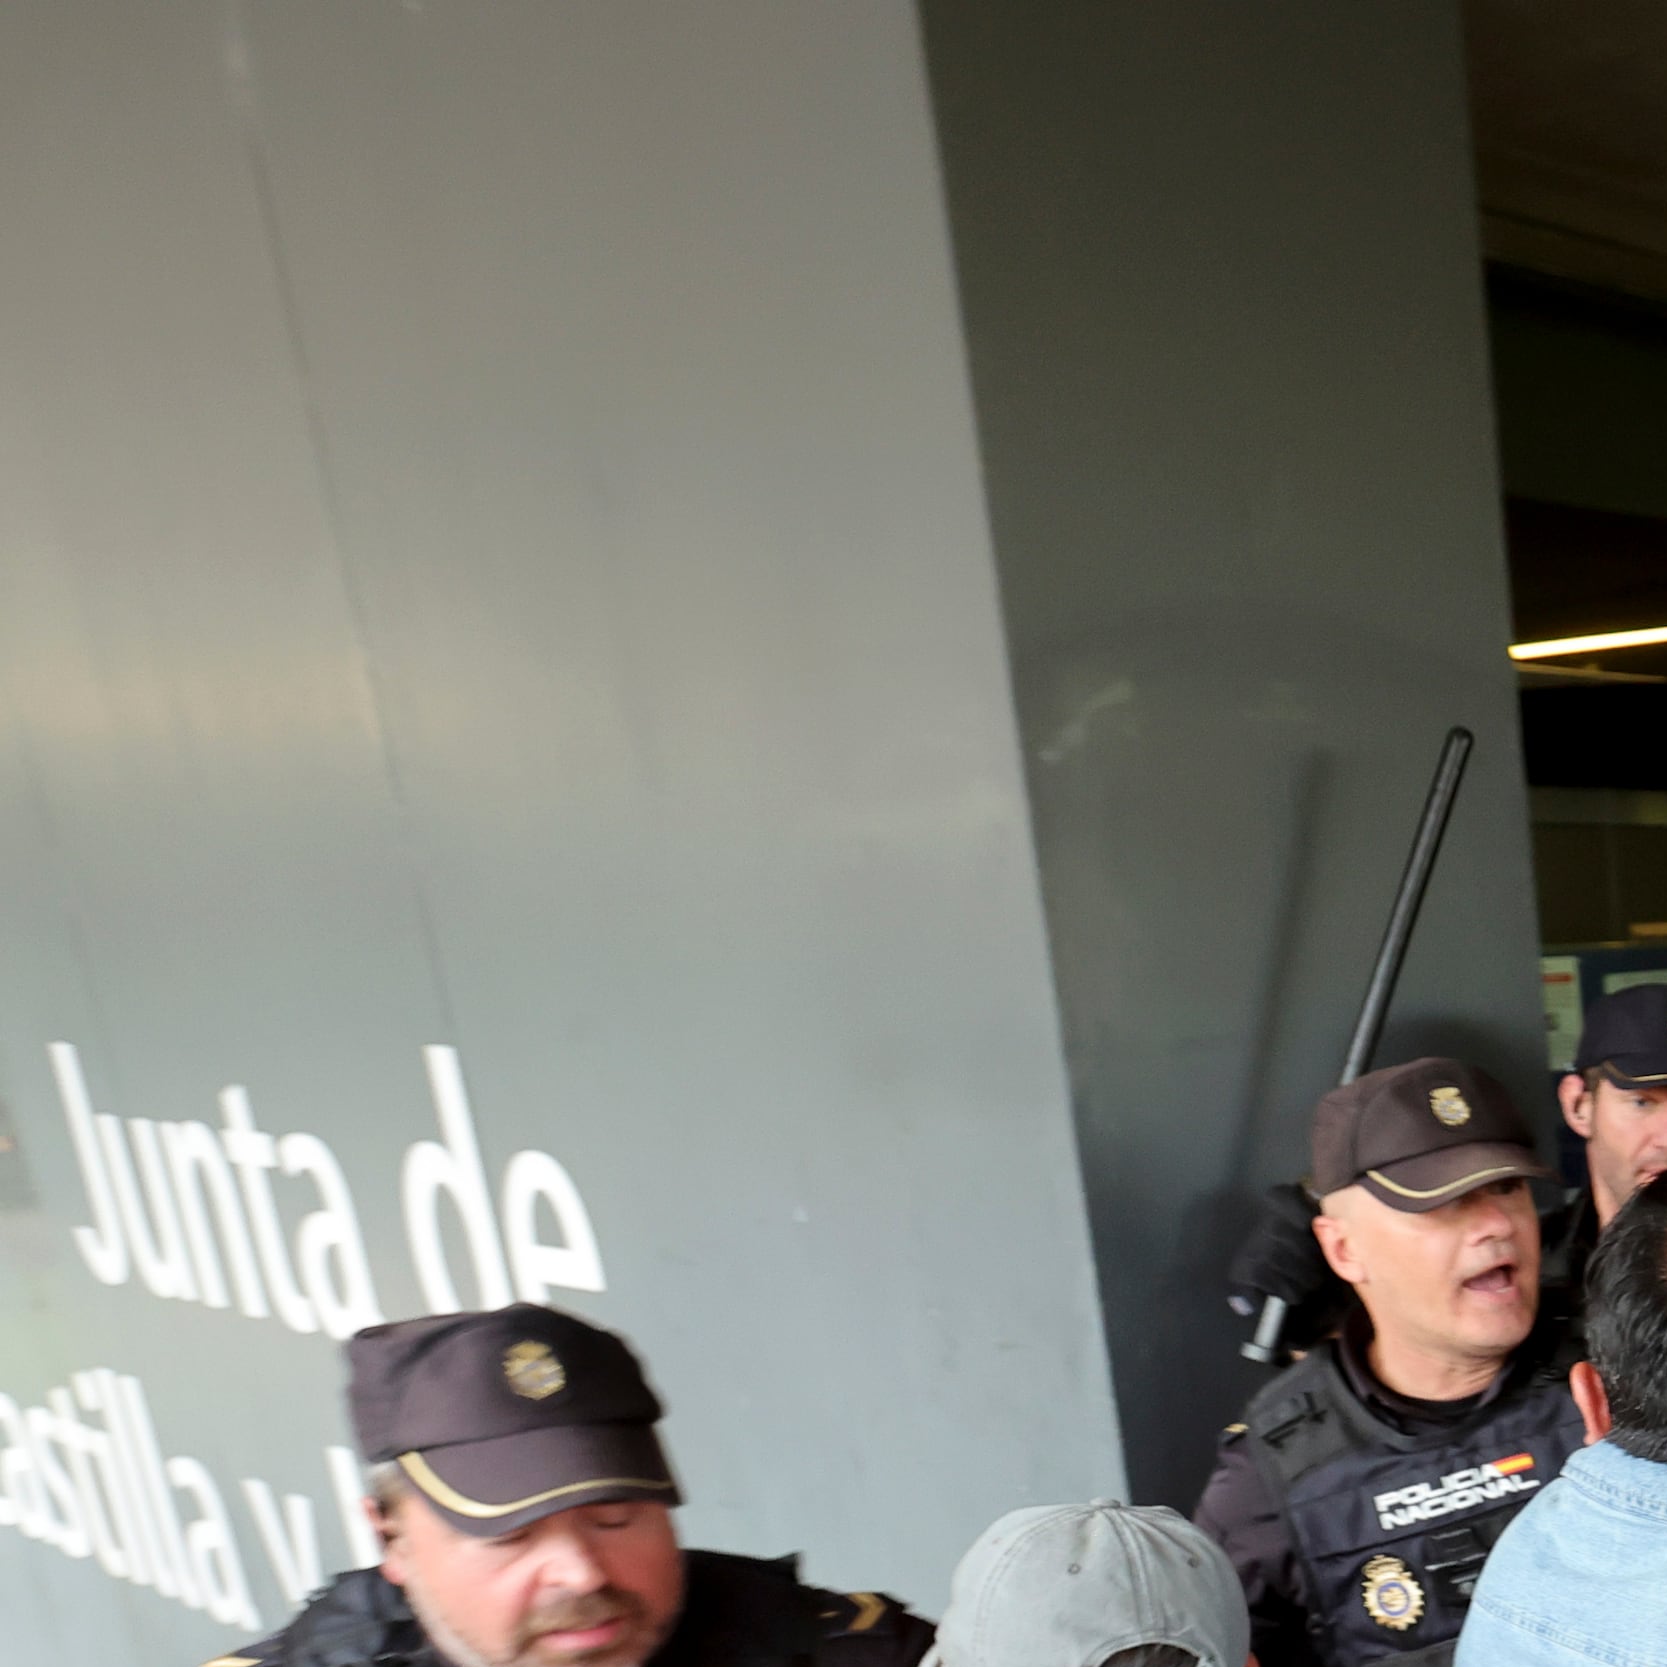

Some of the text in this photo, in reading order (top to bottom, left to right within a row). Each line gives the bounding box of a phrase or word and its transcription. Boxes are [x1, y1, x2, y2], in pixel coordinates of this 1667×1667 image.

[47, 1040, 608, 1342] Junta de
[0, 1367, 262, 1632] astilla
[1373, 1463, 1503, 1512] POLICIA
[1379, 1474, 1541, 1530] NACIONAL
